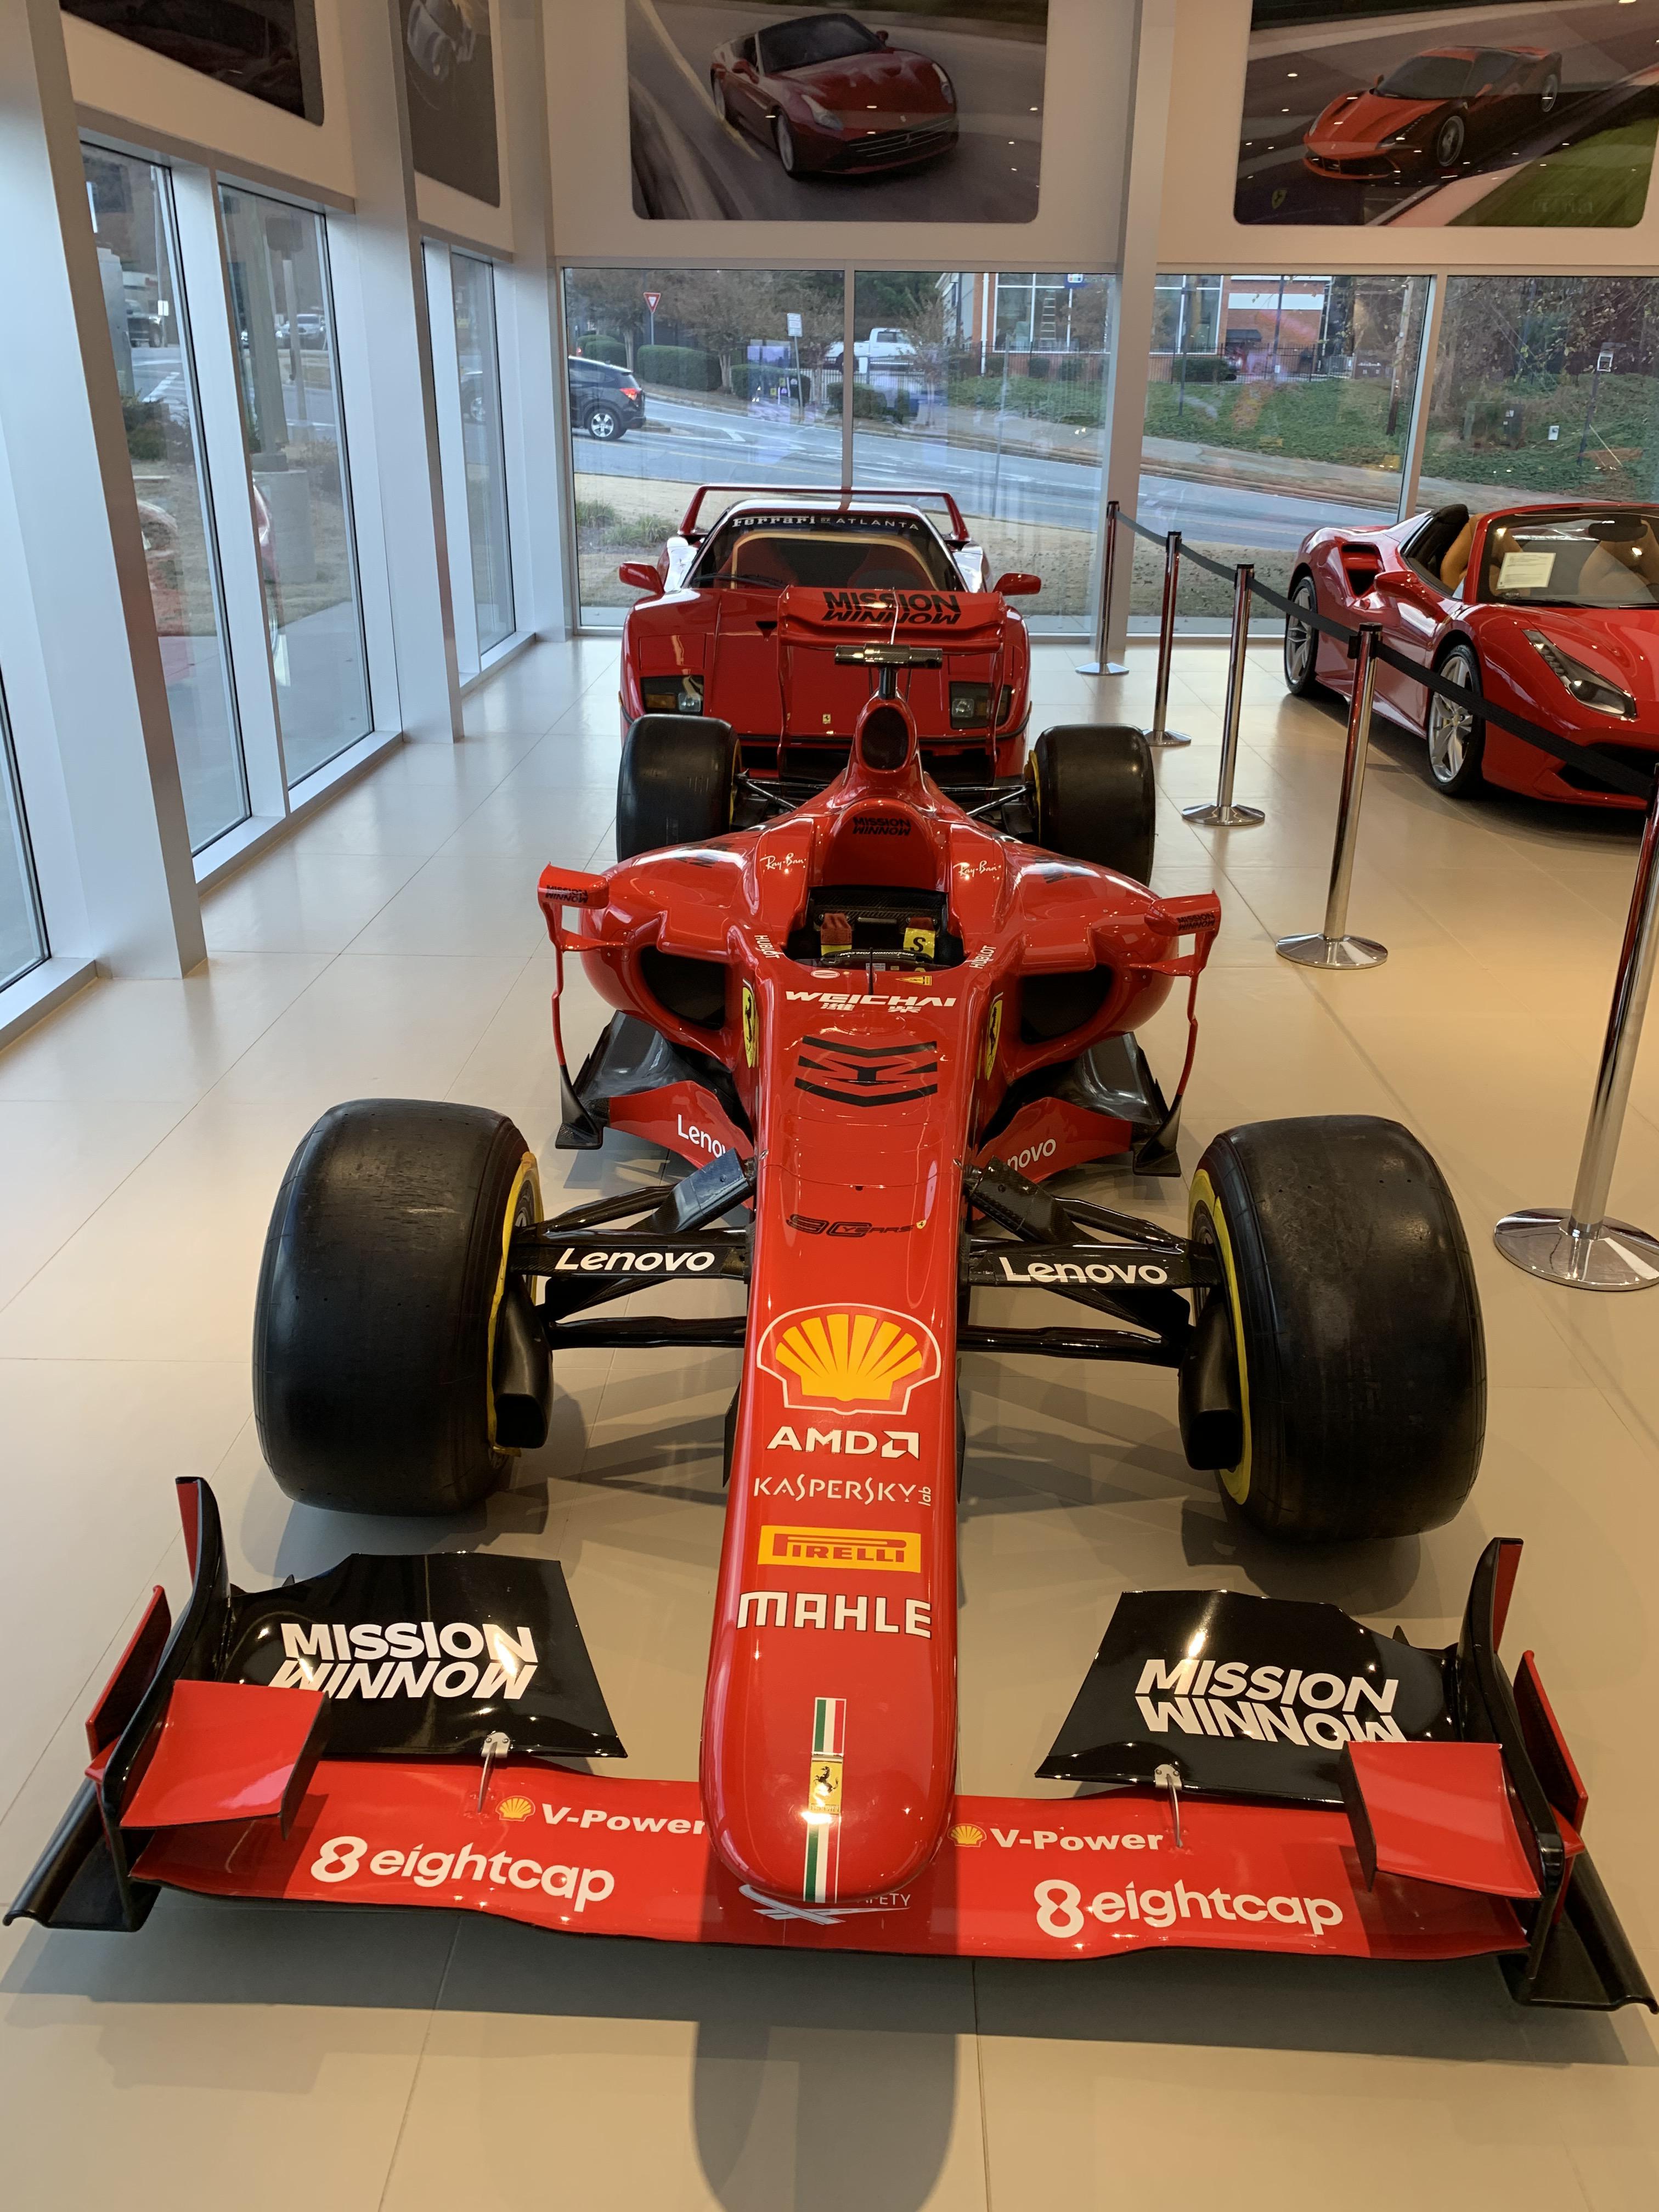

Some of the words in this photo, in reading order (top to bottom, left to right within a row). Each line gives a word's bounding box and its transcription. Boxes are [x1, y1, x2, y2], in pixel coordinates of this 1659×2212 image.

[732, 516, 816, 527] Ferrari
[836, 518, 918, 531] ATLANTA
[823, 591, 961, 613] MISSION
[822, 610, 962, 624] WINNOW
[853, 817, 911, 827] MISSION
[759, 853, 804, 870] Ray-Ban
[953, 860, 997, 878] Ray-Ban
[754, 935, 780, 958] HUBLOT
[910, 936, 926, 952] S
[969, 945, 996, 969] HUBLOT
[786, 991, 957, 1007] WEICHAI
[678, 1114, 726, 1158] Leno
[1007, 1139, 1057, 1171] novo
[555, 1248, 715, 1271] Lenovo
[998, 1257, 1167, 1284] Lenovo
[766, 1426, 878, 1454] AMD
[753, 1474, 916, 1505] KASPERSKY
[918, 1486, 931, 1506] lab
[772, 1533, 906, 1562] PIRELLI
[737, 1591, 931, 1639] MAHLE
[281, 1622, 538, 1663] MISSION
[268, 1660, 538, 1700] WINNOW
[1135, 1659, 1399, 1713] MISSION
[1135, 1696, 1408, 1750] WINNOW
[541, 1803, 705, 1835] V-Power
[990, 1828, 1163, 1850] V-Power
[370, 1842, 614, 1912] eightcap
[1092, 1880, 1343, 1935] eightcap
